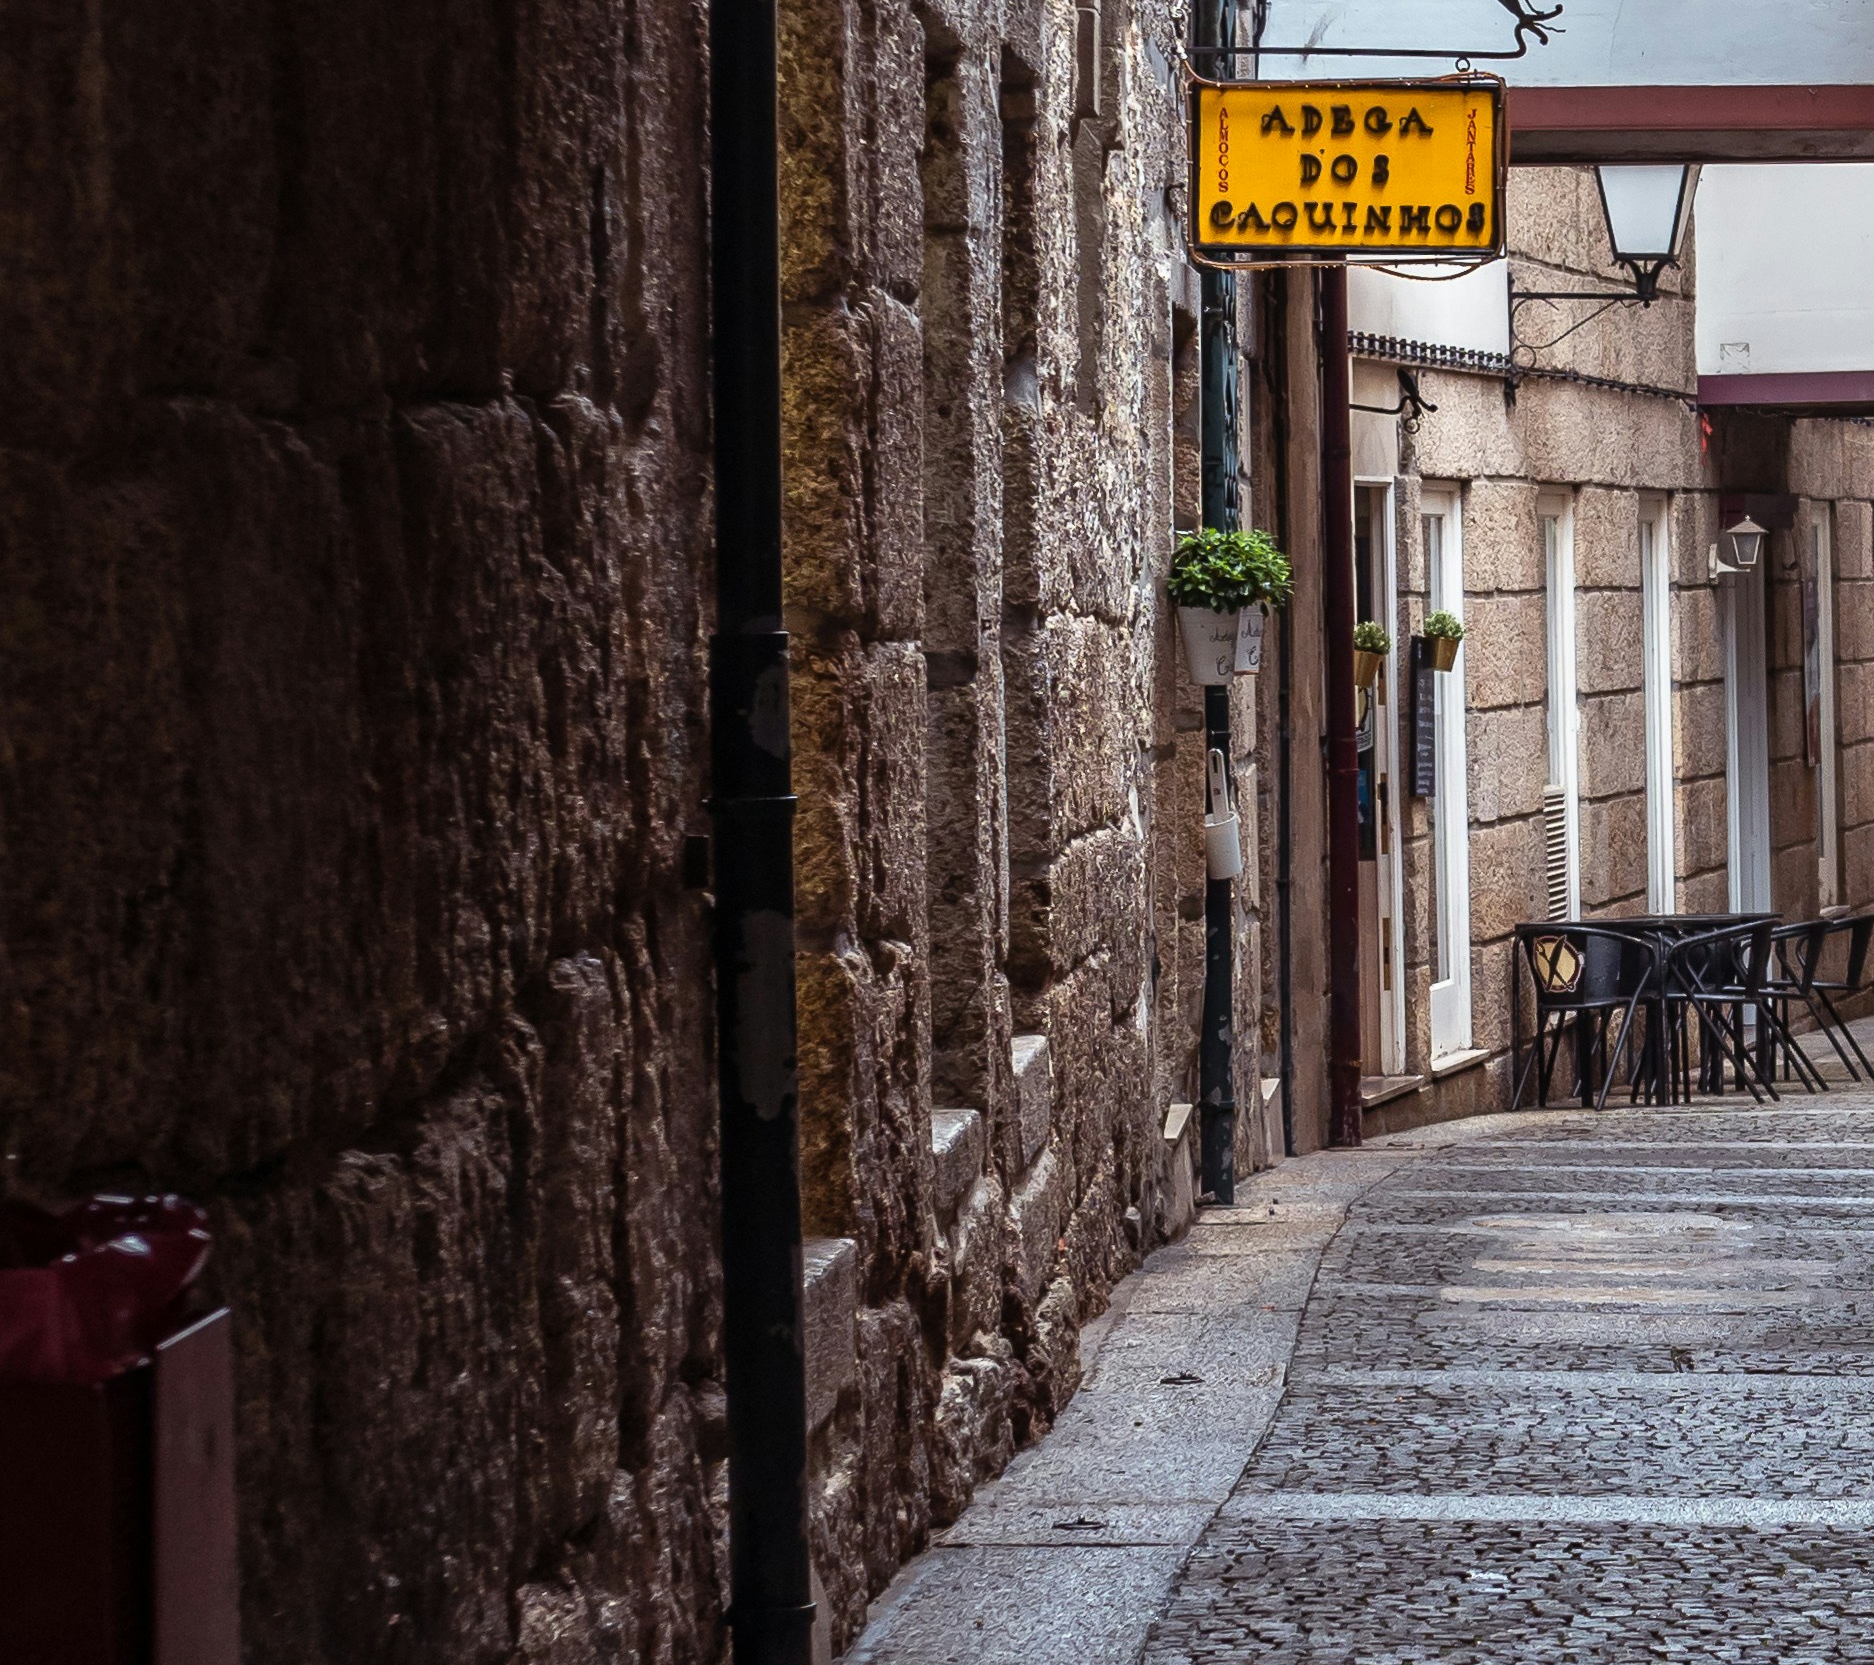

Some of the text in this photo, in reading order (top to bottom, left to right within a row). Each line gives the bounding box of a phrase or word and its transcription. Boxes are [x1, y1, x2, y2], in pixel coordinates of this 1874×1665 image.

[1260, 104, 1434, 136] ADEGA
[1464, 108, 1478, 195] JANTARES
[1209, 200, 1485, 234] CAQUINHOS
